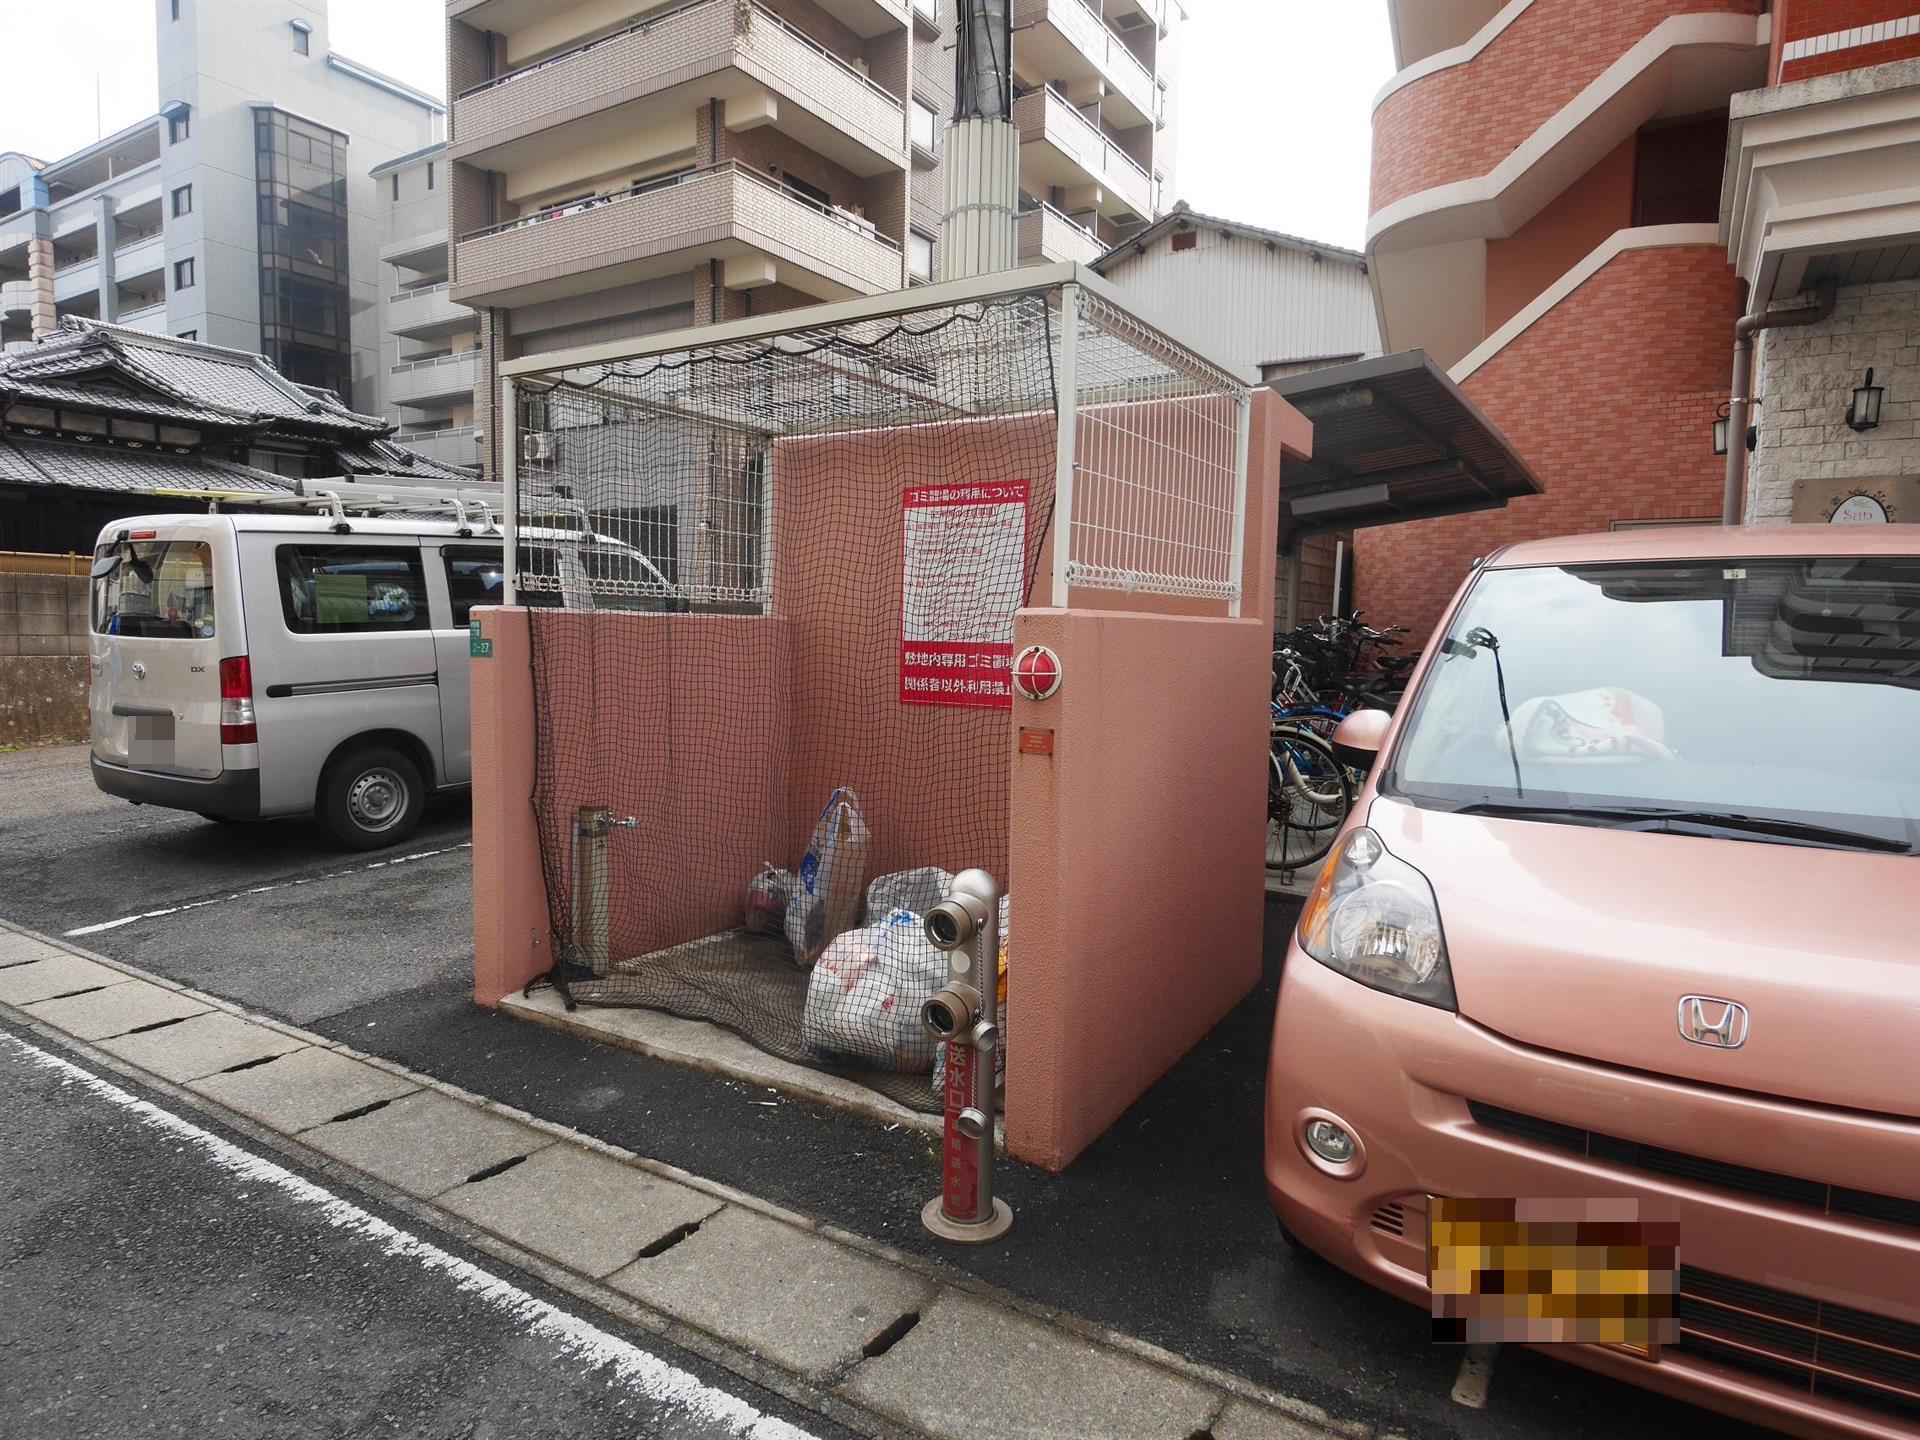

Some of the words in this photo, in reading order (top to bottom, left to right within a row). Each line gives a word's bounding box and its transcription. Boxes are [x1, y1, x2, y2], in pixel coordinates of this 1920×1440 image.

[910, 485, 1025, 503] ゴミ置場の利用について
[949, 1045, 966, 1109] 送水口
